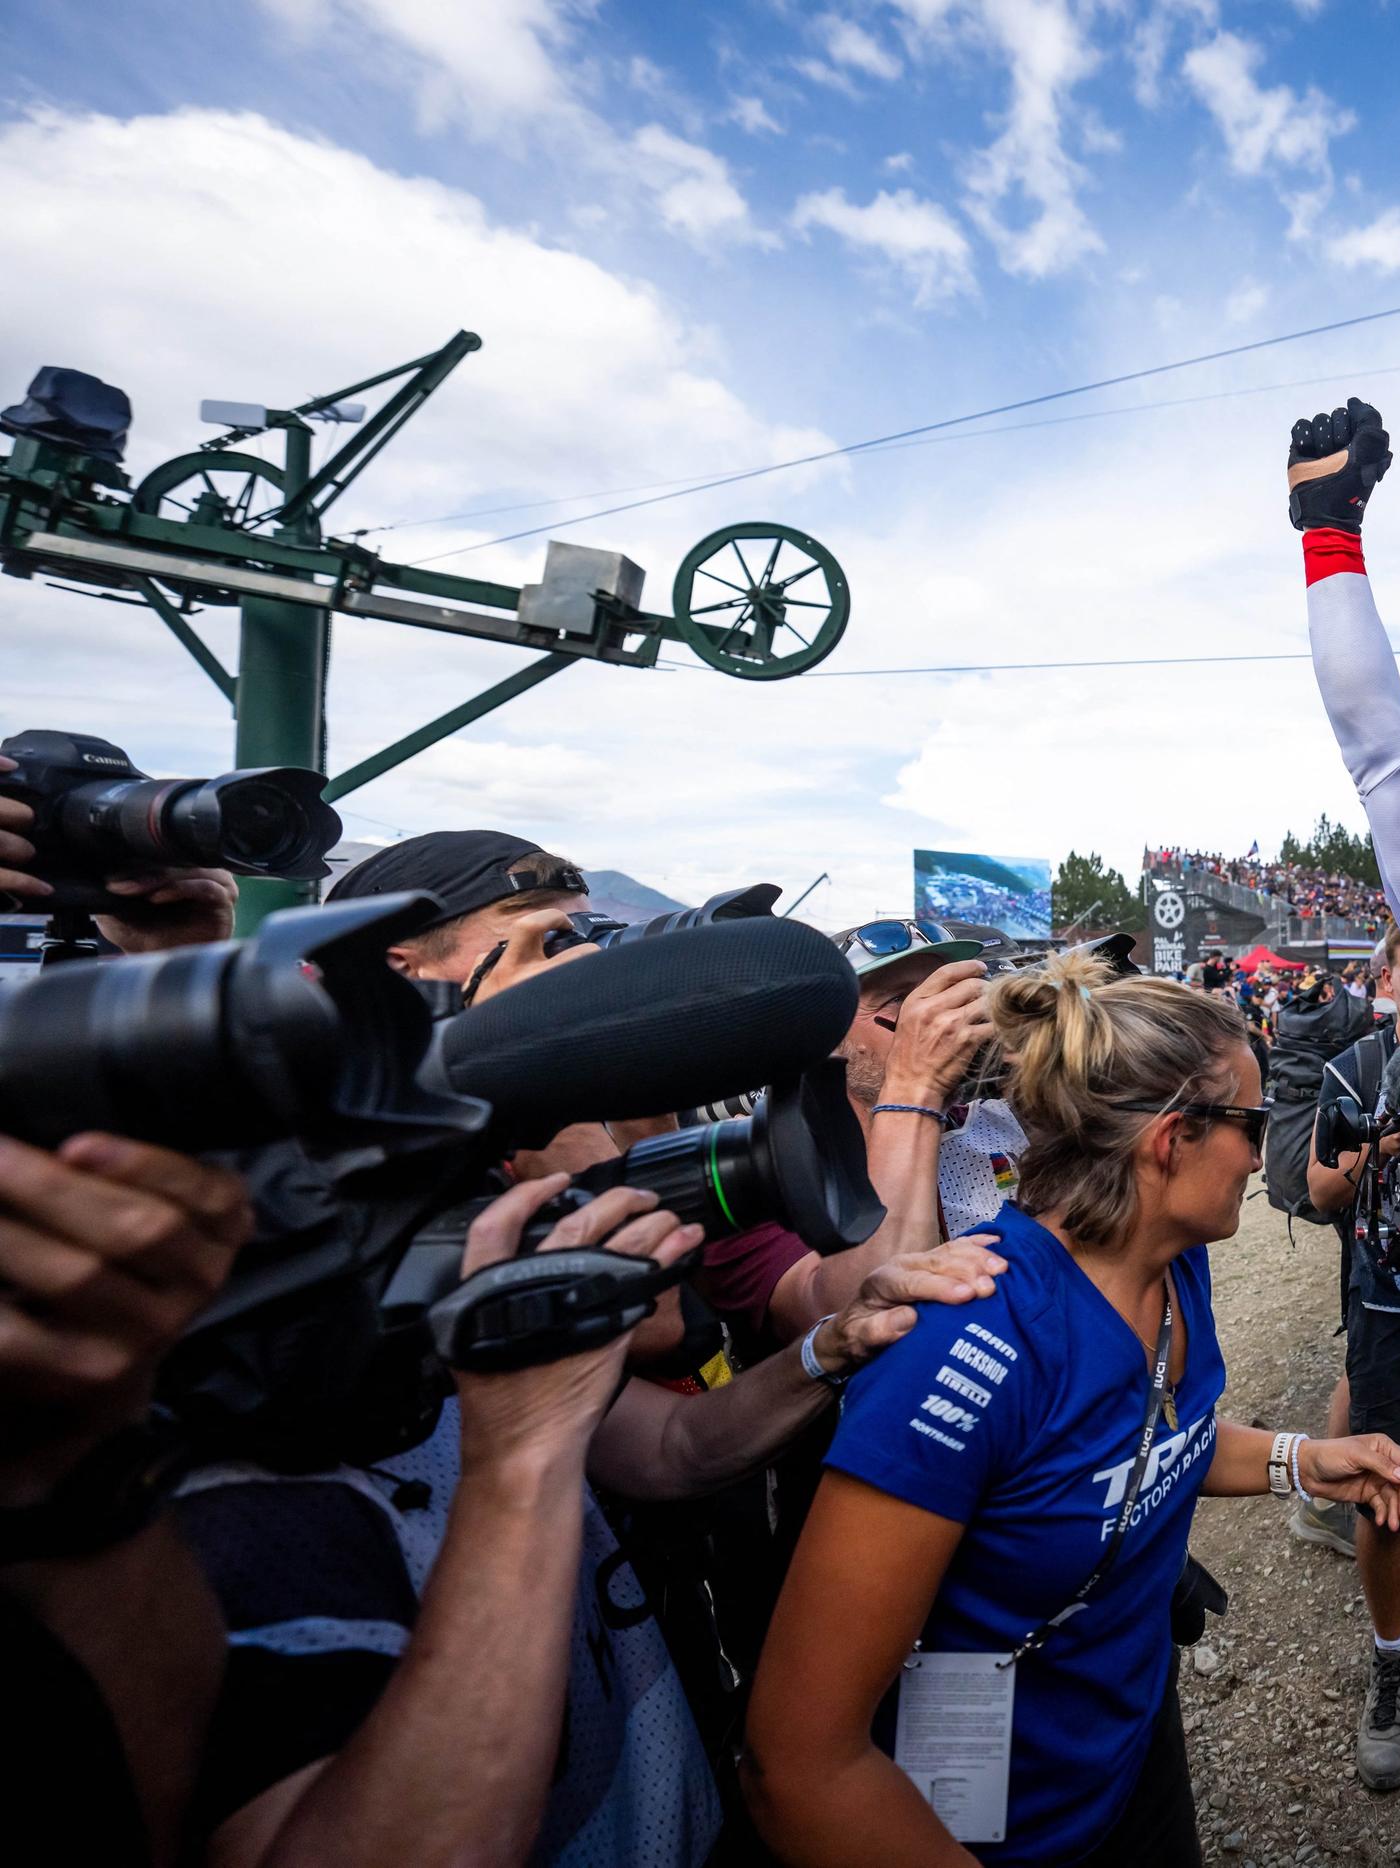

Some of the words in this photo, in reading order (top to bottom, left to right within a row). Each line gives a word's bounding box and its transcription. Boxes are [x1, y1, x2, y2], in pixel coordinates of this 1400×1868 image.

[83, 753, 129, 768] Canon
[1154, 951, 1182, 961] BIKE
[964, 1322, 1018, 1361] SRAM
[949, 1338, 1009, 1385] ROCKSHOX
[936, 1365, 993, 1408] PIRELLI
[920, 1394, 980, 1432] 100%
[1142, 1427, 1154, 1453] UCI
[1101, 1464, 1181, 1542] FCTORY
[1181, 1418, 1218, 1475] RACIN
